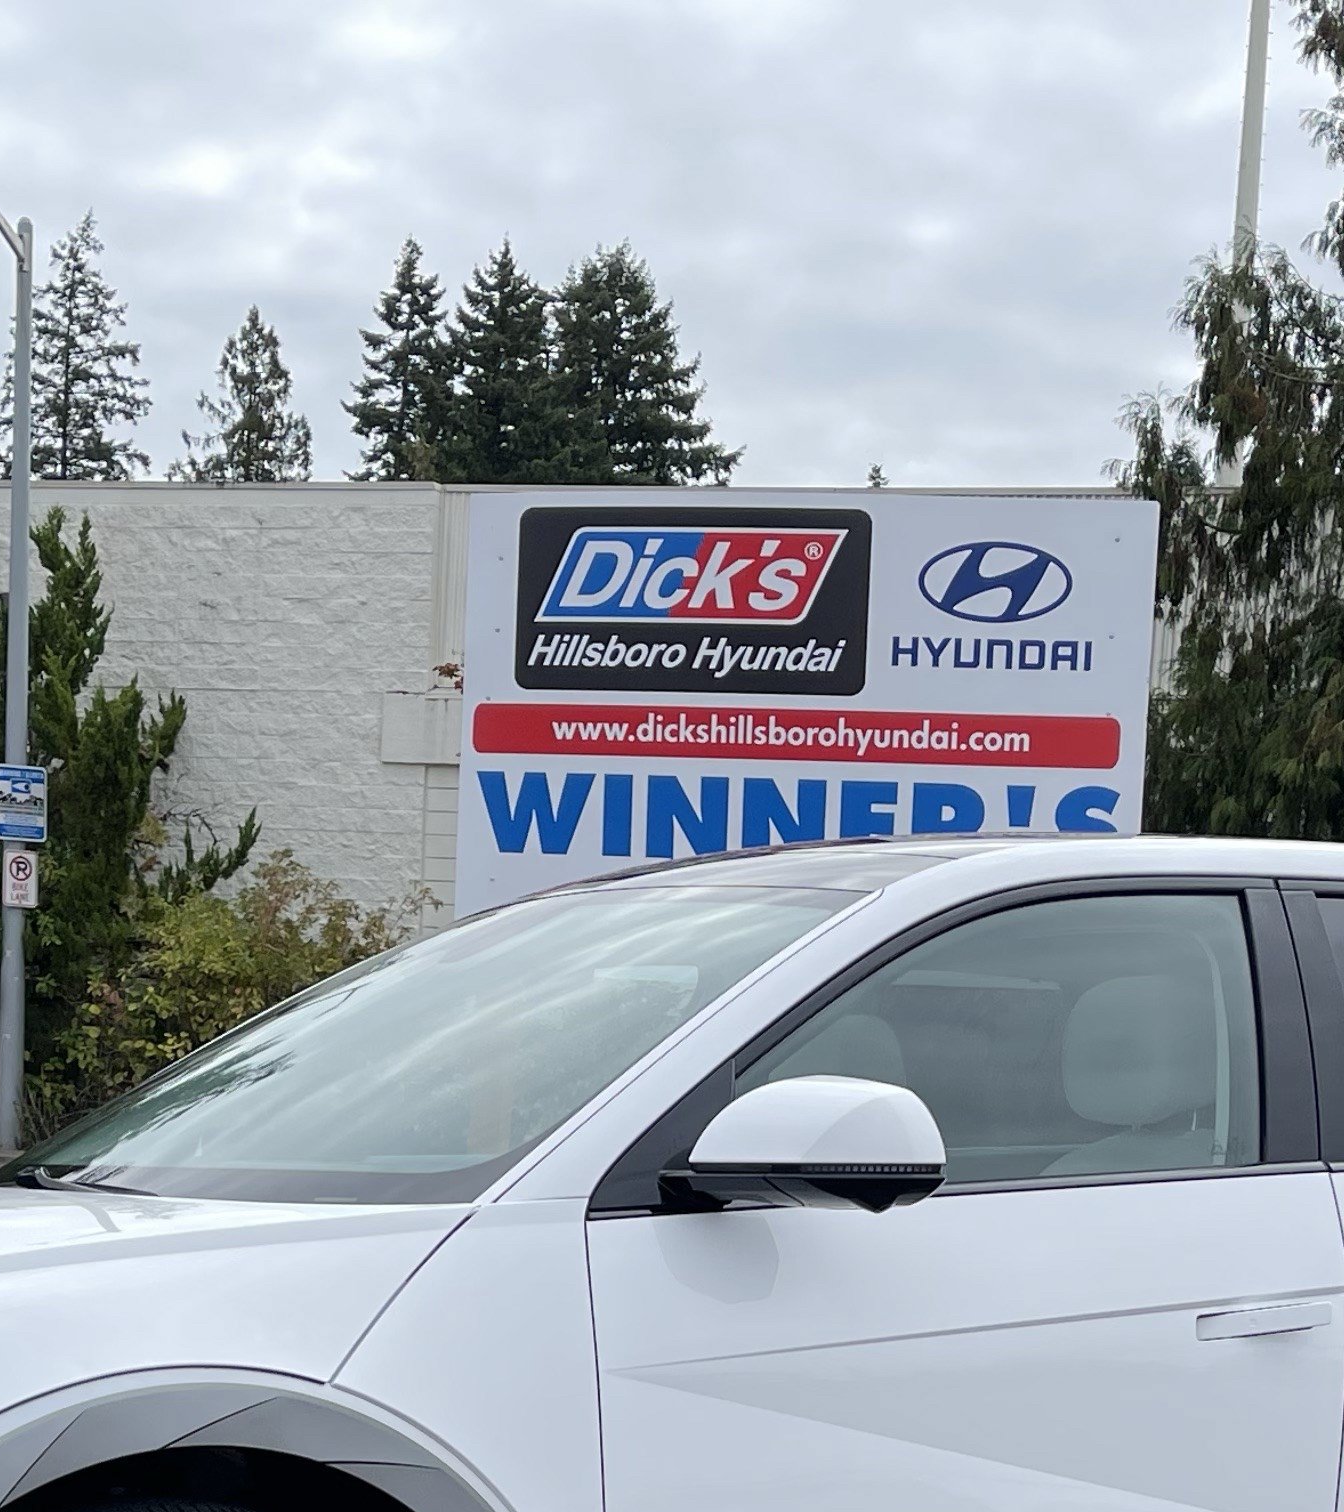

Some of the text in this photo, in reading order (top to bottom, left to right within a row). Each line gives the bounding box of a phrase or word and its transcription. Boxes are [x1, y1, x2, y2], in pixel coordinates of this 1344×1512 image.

[559, 538, 807, 611] Dick's
[527, 634, 847, 680] Hillsboro Hyundai
[891, 636, 1093, 672] HYUNDAI
[552, 714, 1031, 756] www.dickshillsborohyundai.com
